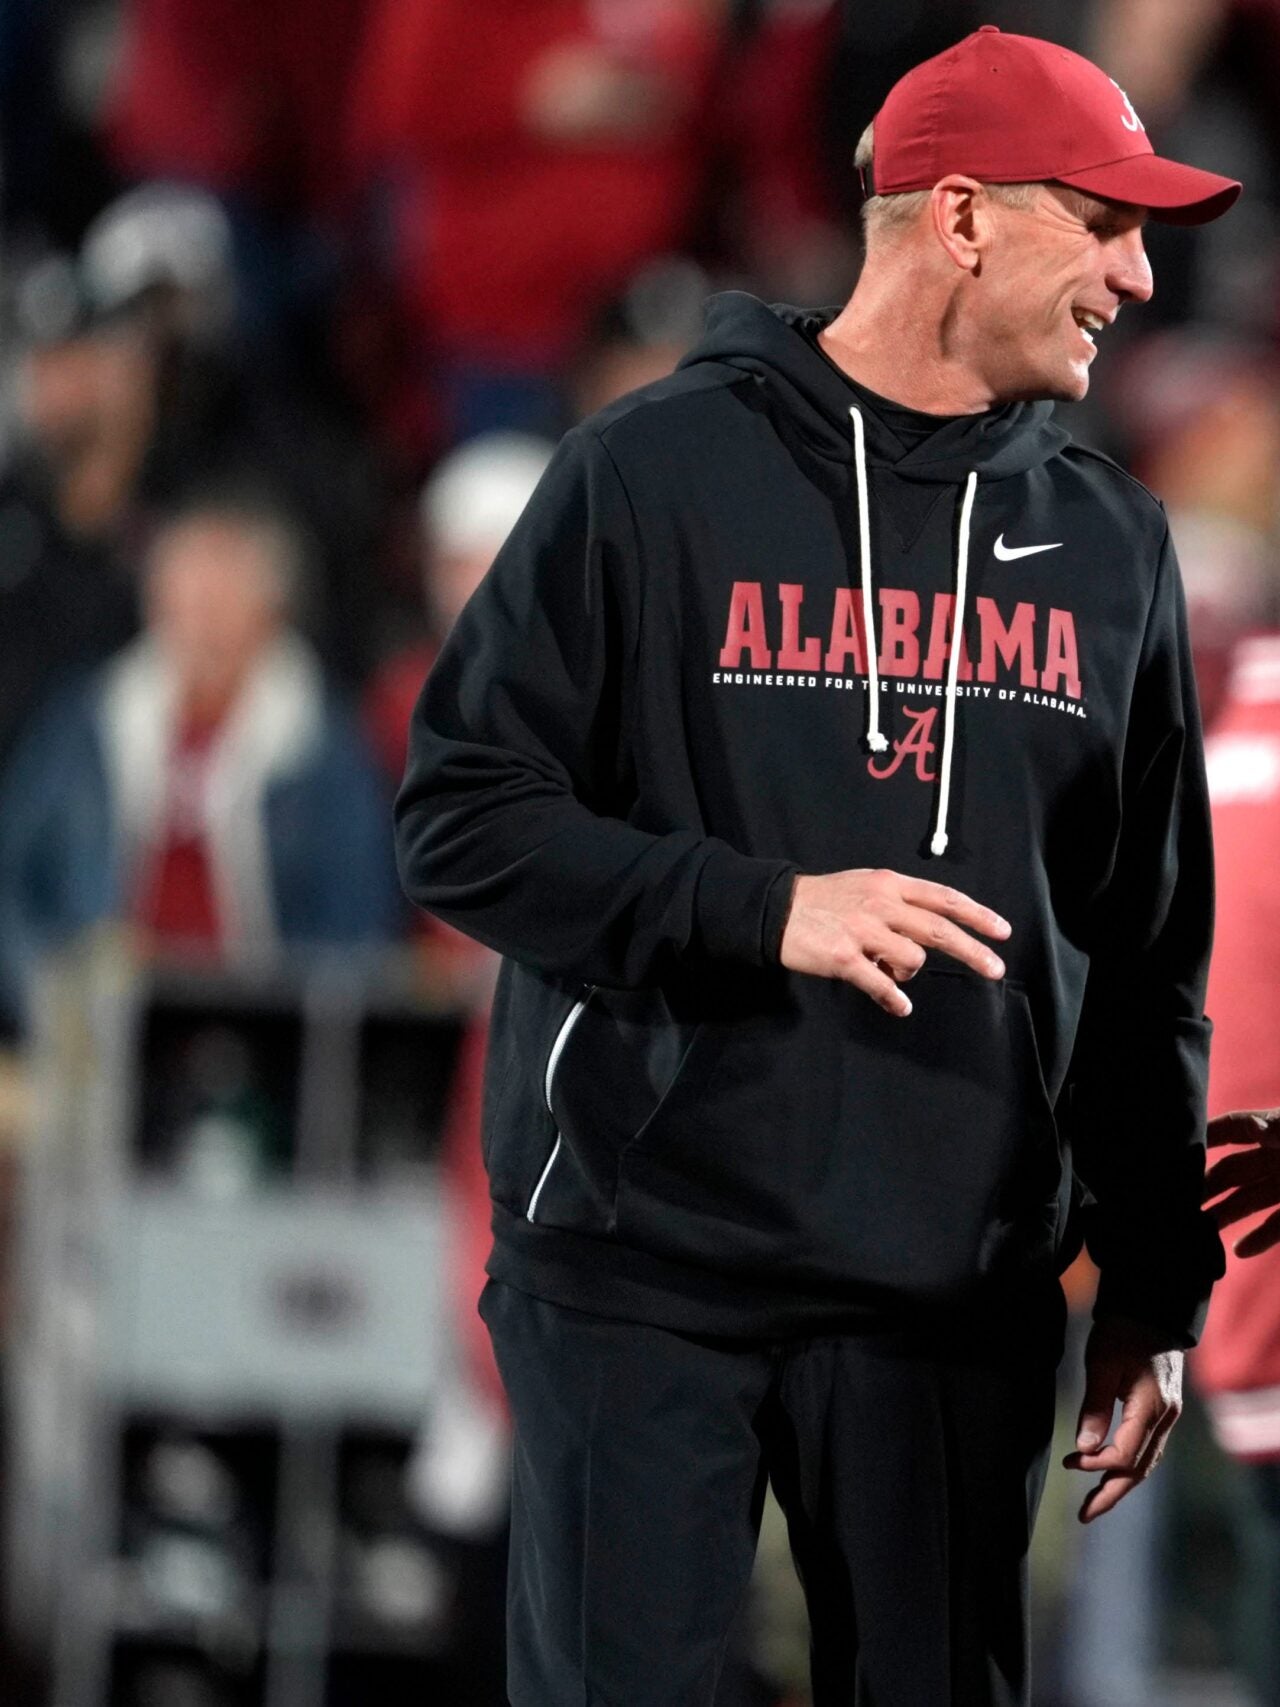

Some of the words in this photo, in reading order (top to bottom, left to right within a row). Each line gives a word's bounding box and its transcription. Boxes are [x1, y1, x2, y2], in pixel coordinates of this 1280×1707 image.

[719, 581, 1082, 700] ALABAMA
[712, 673, 817, 688] ENGINEERED
[825, 677, 853, 690] FOR
[861, 680, 888, 692] TE
[896, 682, 991, 698] UNIVESITY
[998, 688, 1017, 700] OF
[867, 705, 939, 782] A
